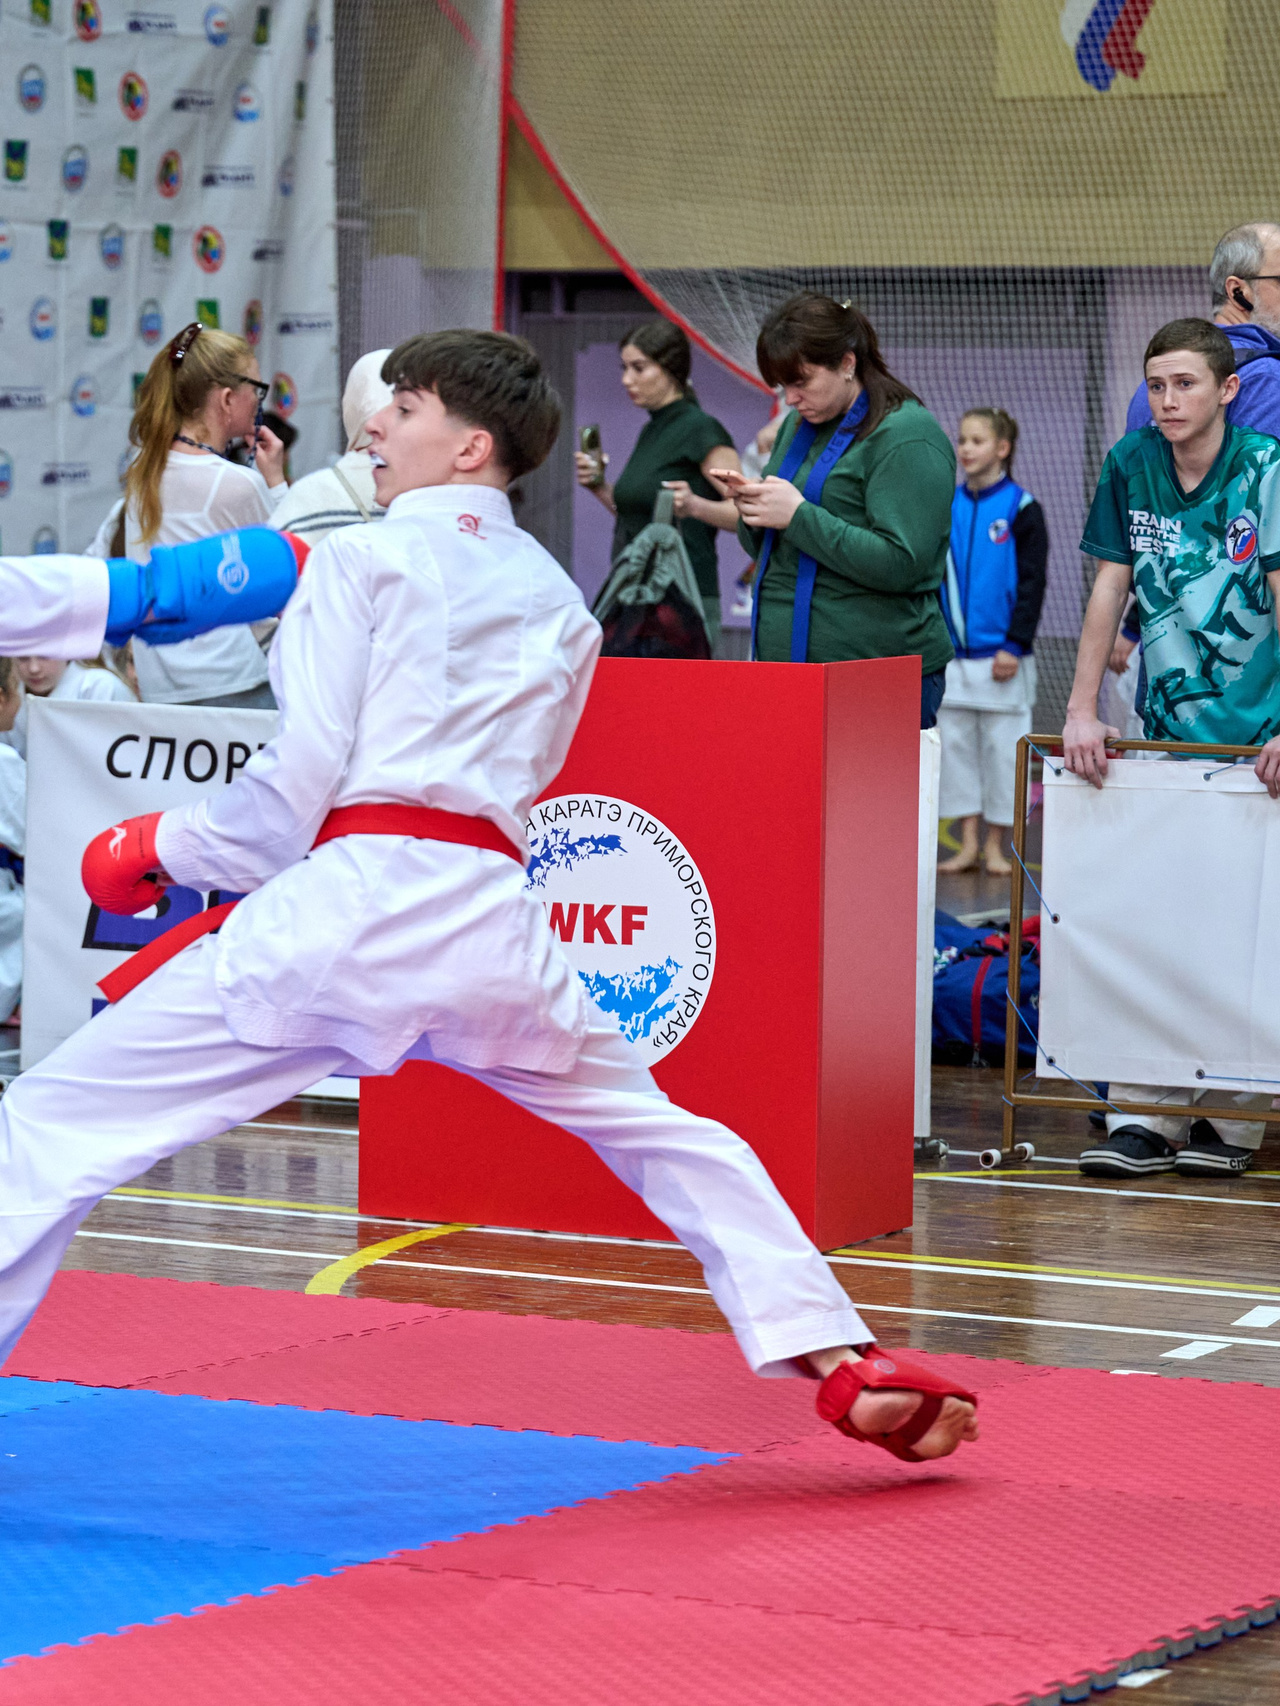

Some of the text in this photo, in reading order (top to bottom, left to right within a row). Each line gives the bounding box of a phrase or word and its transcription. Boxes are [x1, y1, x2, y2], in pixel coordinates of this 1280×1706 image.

[1129, 525, 1156, 537] ITH
[106, 733, 267, 784] СПОР
[539, 799, 622, 826] КАРАТЭ
[627, 811, 712, 981] ПРИМОРСКОГО
[543, 901, 648, 946] WKF
